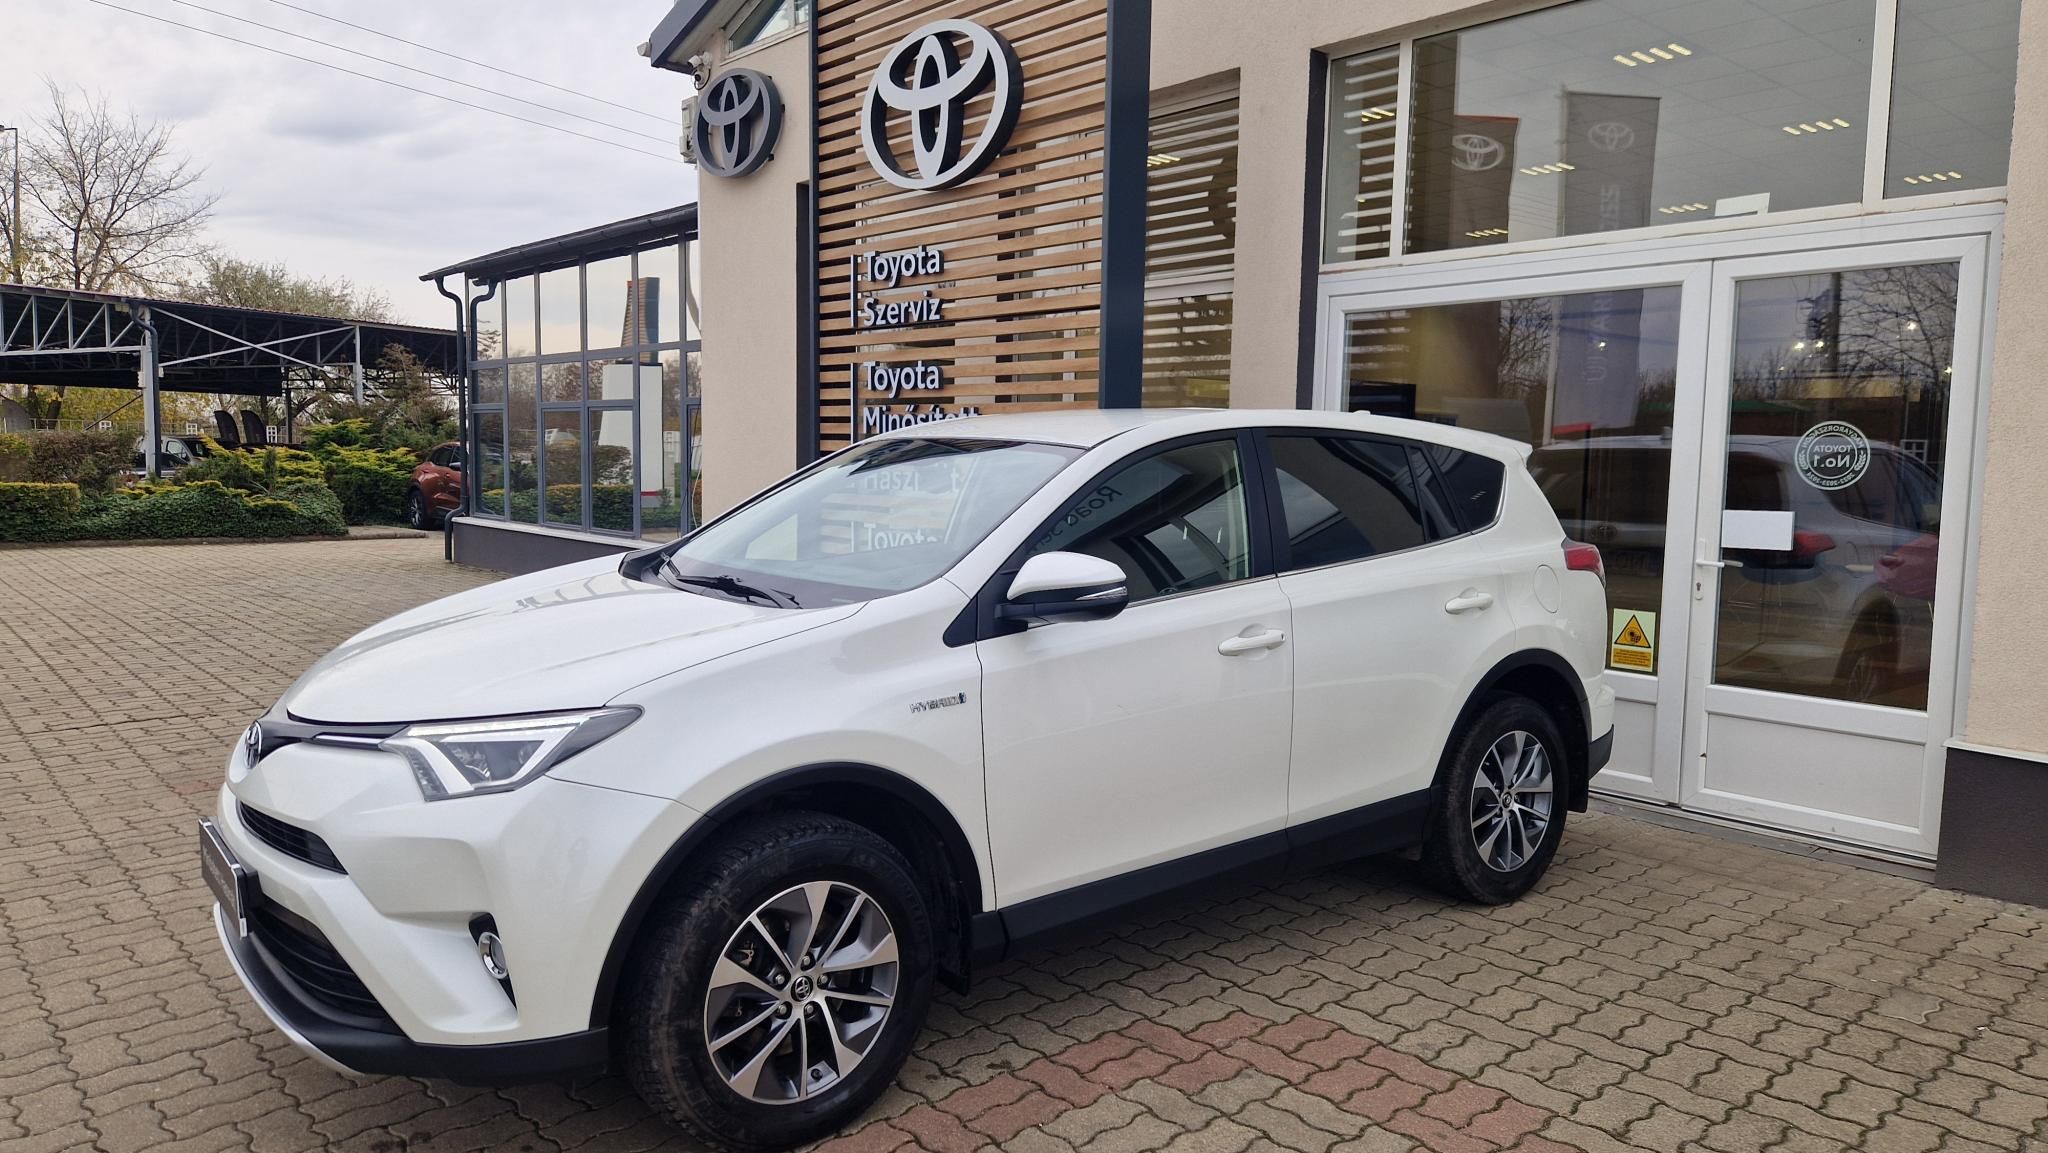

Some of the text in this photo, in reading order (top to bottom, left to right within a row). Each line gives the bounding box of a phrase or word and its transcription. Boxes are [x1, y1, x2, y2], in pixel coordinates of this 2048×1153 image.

[863, 246, 941, 287] Toyota
[863, 290, 943, 327] Szerviz
[863, 361, 940, 398] Toyota
